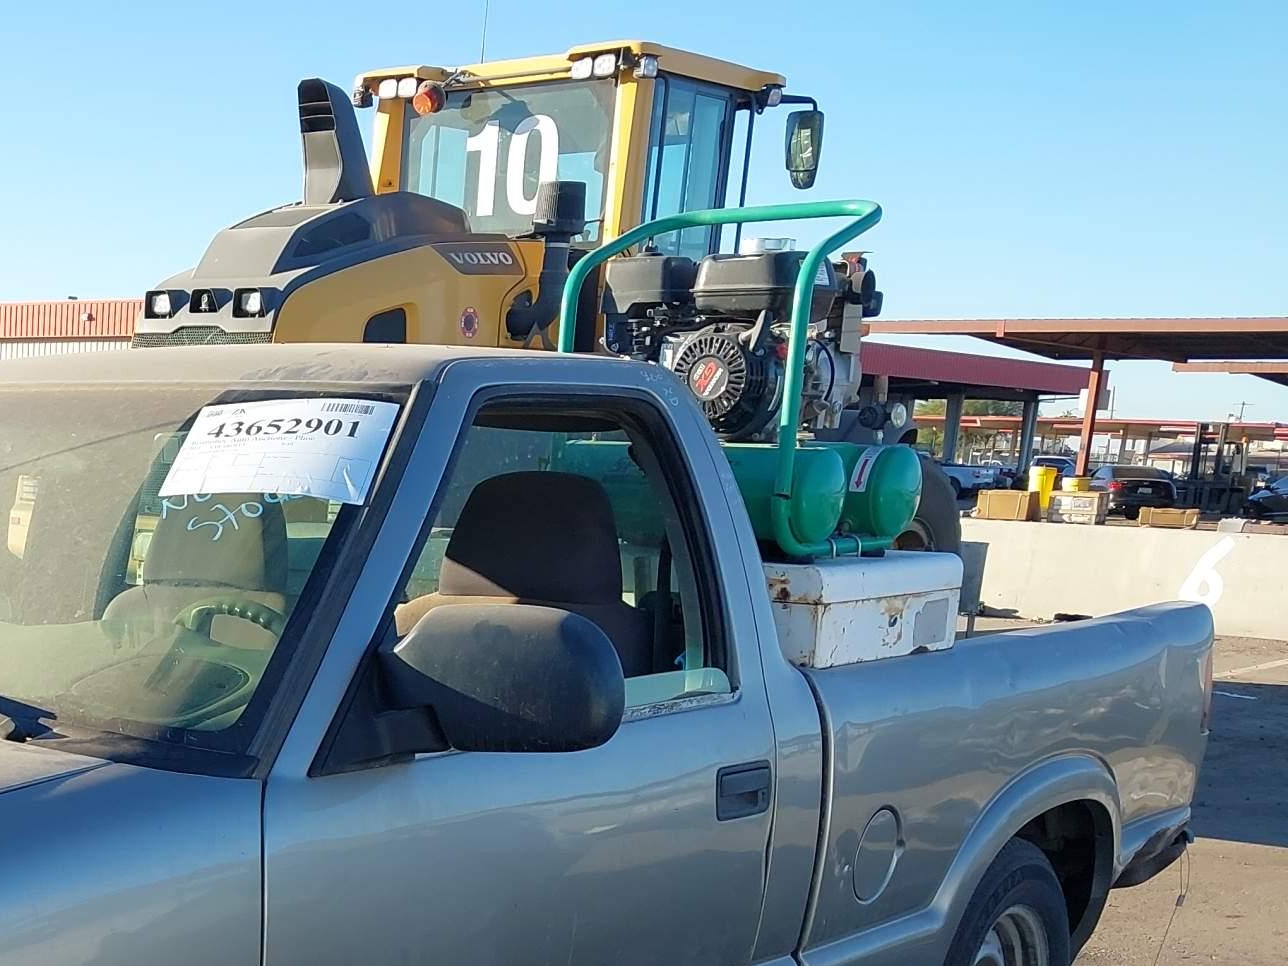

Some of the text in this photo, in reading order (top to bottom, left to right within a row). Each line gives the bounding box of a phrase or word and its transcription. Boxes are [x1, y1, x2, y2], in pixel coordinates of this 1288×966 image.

[466, 114, 559, 216] 10
[448, 252, 513, 265] VOLVO
[207, 417, 363, 439] 43652901
[1178, 535, 1235, 605] 6
